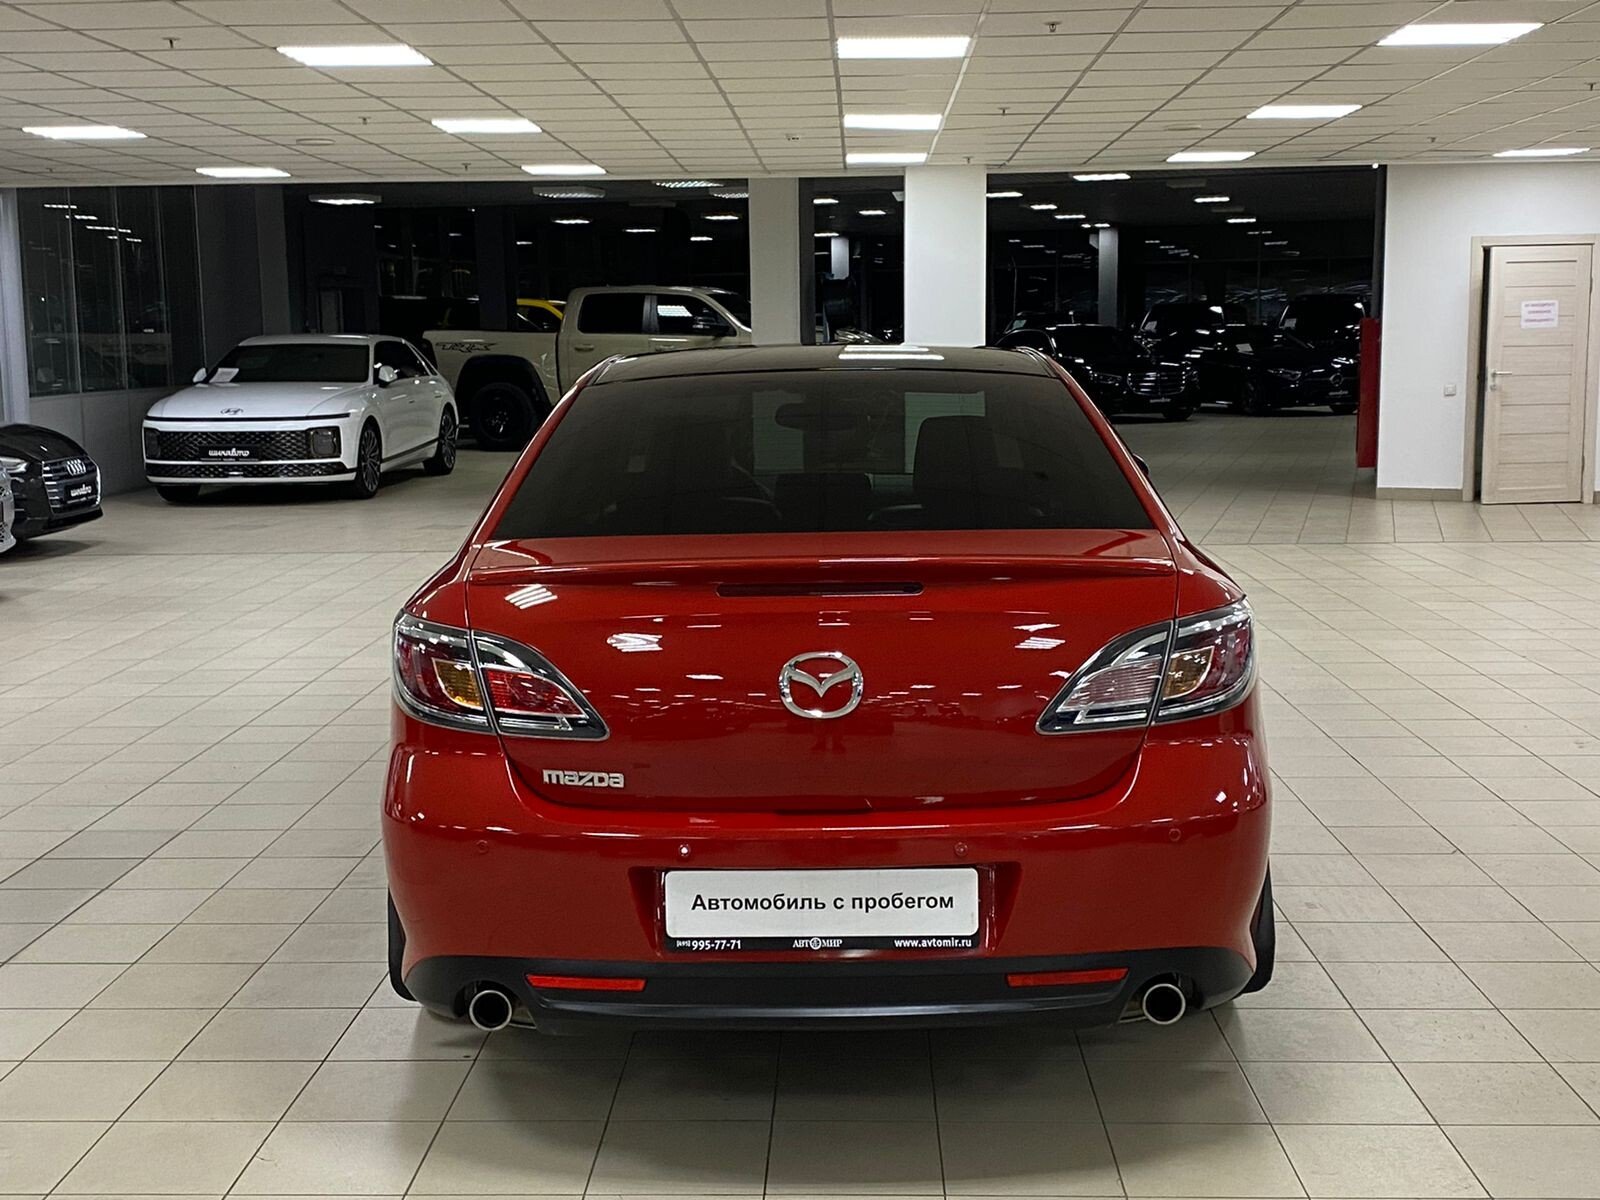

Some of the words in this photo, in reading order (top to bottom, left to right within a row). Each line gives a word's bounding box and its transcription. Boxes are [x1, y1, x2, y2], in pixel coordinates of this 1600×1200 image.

[691, 893, 826, 910] Автомобиль
[833, 897, 844, 909] с
[852, 892, 953, 913] пробегом
[692, 940, 741, 951] 995-77-71
[894, 937, 972, 947] www.avtomir.ru
